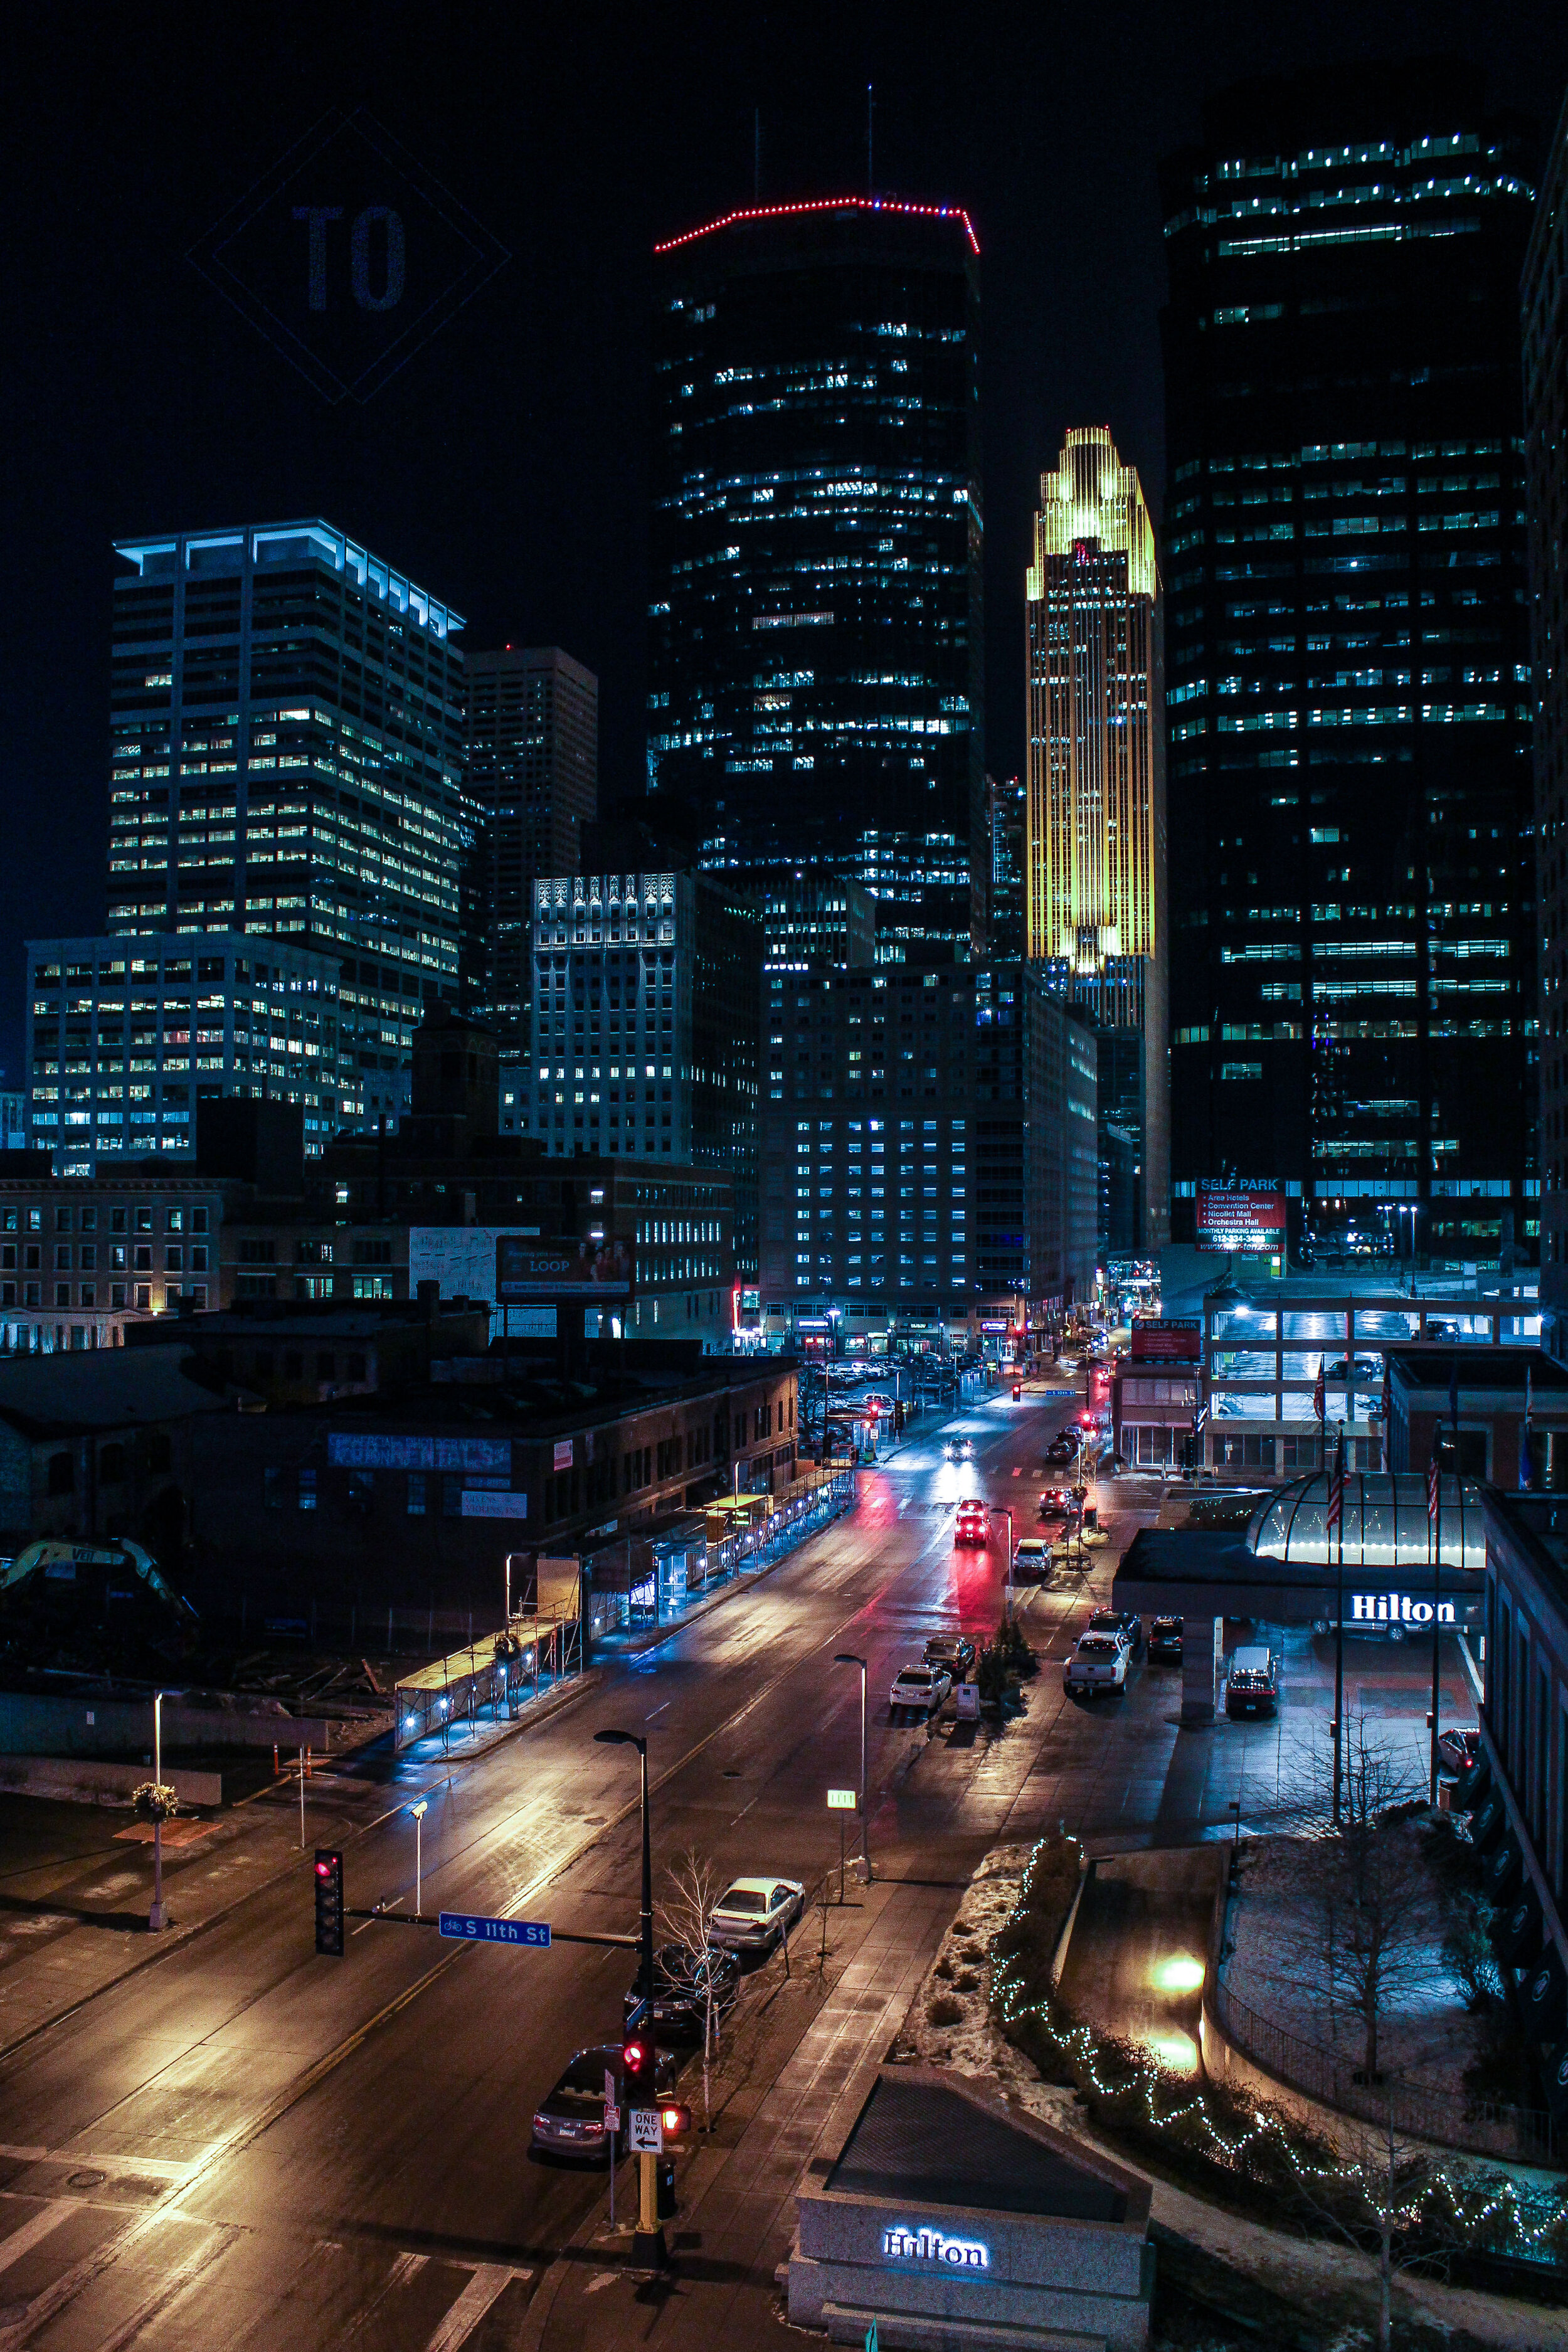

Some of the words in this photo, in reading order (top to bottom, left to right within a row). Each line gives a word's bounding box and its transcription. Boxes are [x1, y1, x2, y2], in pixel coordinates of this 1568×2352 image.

[1201, 1179, 1237, 1190] SELF
[1239, 1179, 1279, 1190] PARK
[530, 1261, 570, 1272] LOOP
[1145, 1320, 1169, 1328] SELF
[1172, 1320, 1197, 1328] PARK
[1352, 1593, 1456, 1622] Hilton
[466, 1920, 477, 1934] S
[485, 1922, 517, 1939] 11th
[526, 1927, 546, 1942] St
[635, 2114, 657, 2125] ONE
[635, 2125, 657, 2136] WAY
[884, 2232, 985, 2267] Hilton
